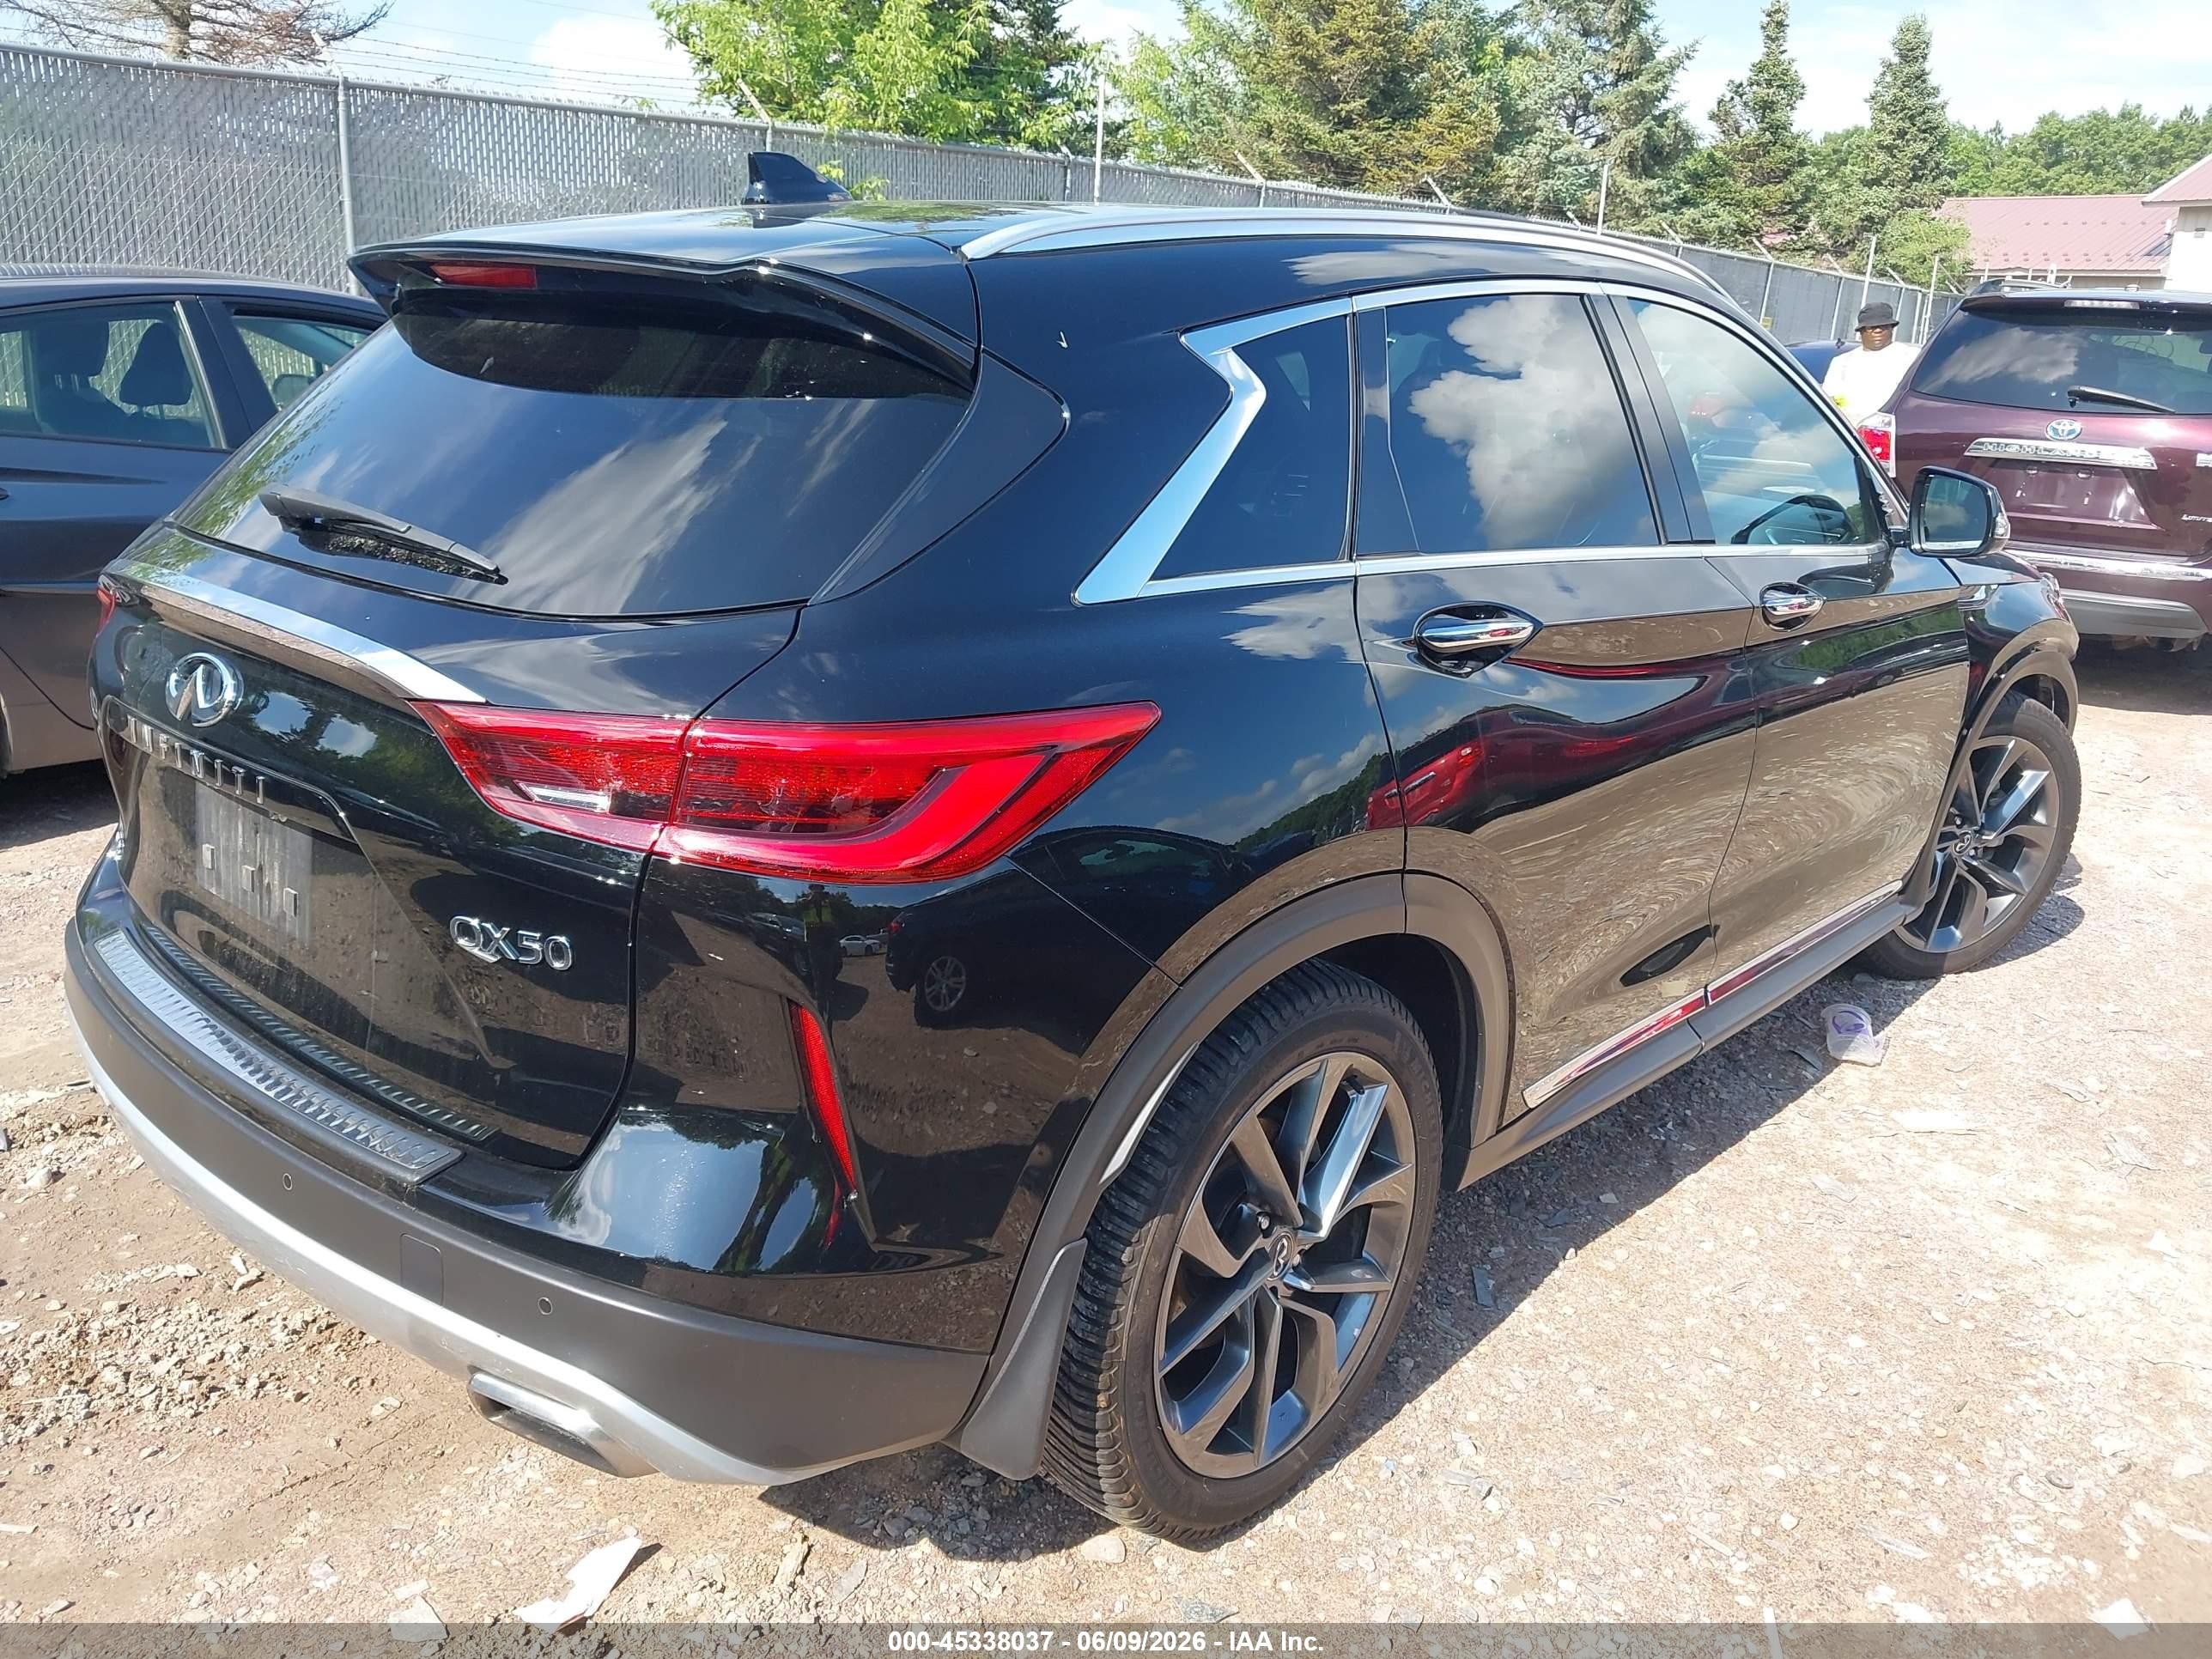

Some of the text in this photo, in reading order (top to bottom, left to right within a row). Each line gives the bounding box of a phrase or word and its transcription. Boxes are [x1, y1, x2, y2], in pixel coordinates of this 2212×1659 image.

[1983, 441, 2132, 462] HIGHLAND
[127, 714, 265, 805] INFINITI
[450, 915, 572, 970] QX50
